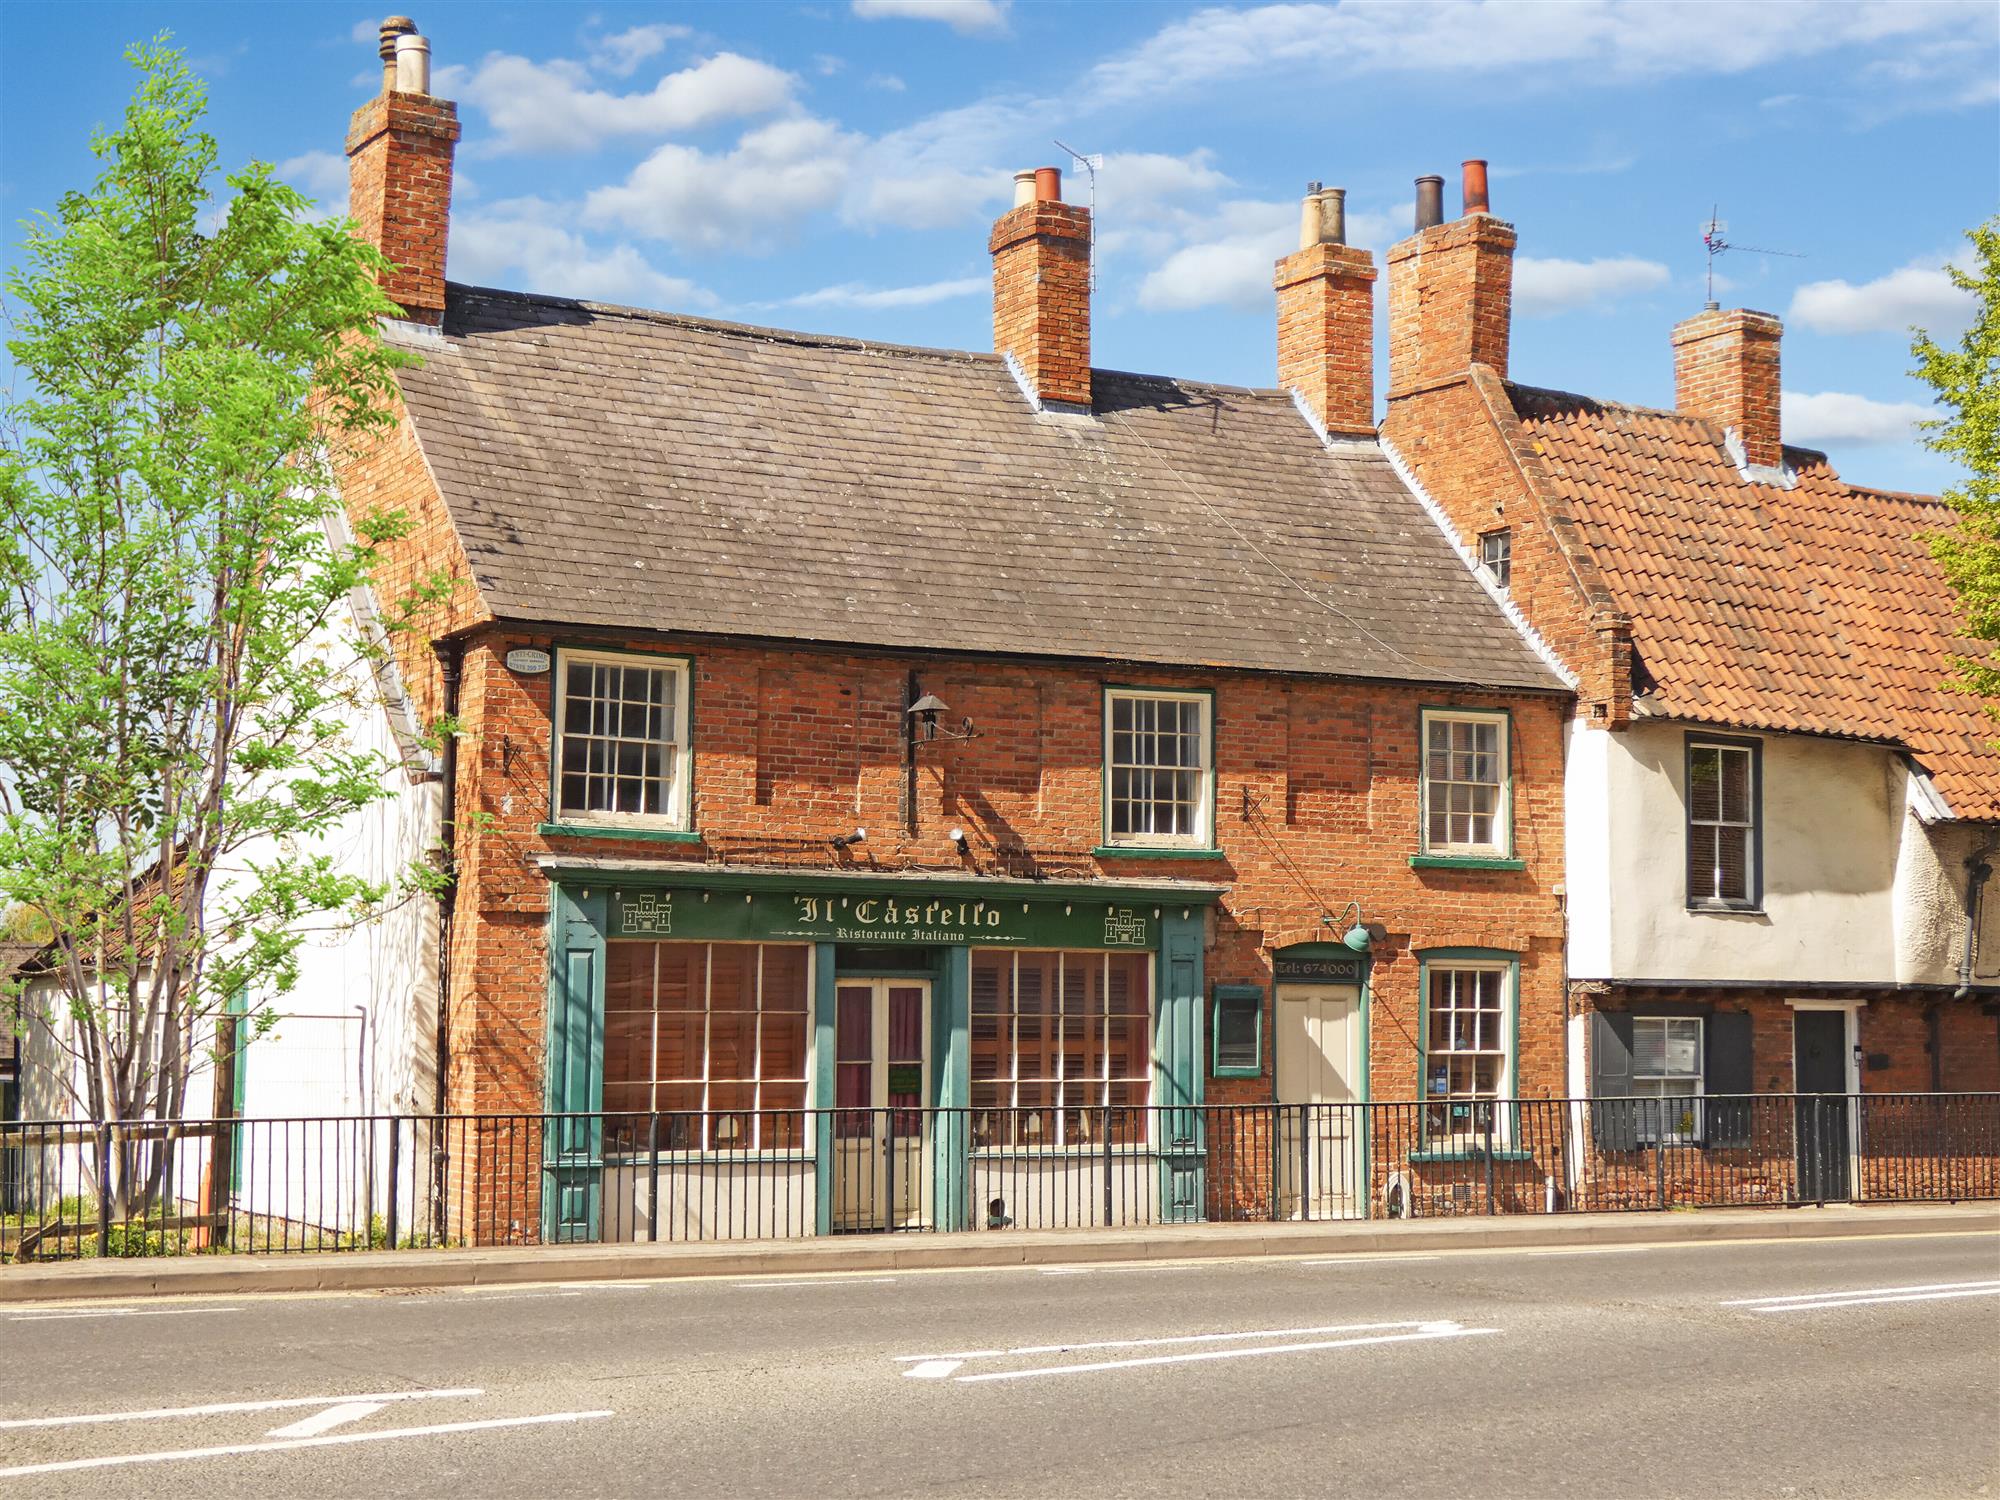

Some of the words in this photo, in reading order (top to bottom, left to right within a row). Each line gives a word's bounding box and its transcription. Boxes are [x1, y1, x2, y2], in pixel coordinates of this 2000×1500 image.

[798, 897, 834, 922] Il
[855, 900, 1000, 926] Castello
[836, 927, 906, 940] Ristorante
[911, 929, 965, 941] Italiano
[1276, 962, 1300, 974] Tel:
[1303, 963, 1355, 975] 674000
